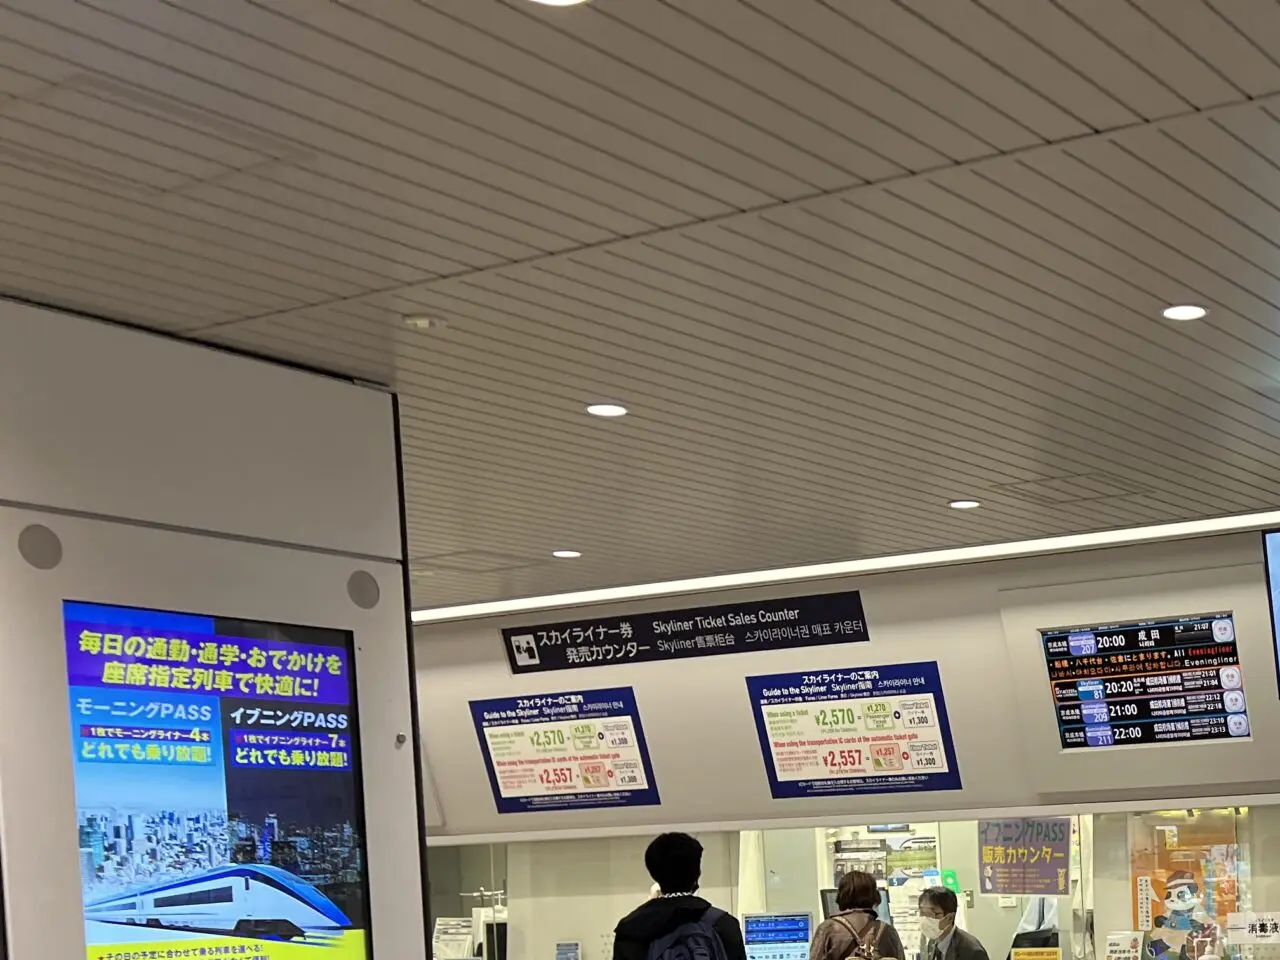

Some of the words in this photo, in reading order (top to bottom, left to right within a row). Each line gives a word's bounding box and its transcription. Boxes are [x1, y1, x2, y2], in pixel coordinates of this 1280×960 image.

[652, 617, 694, 635] Skyliner
[694, 615, 727, 630] Ticket
[727, 611, 757, 627] Sales
[758, 608, 800, 624] Counter
[1194, 623, 1209, 631] 21:07
[537, 622, 634, 647] スカイライナー券
[744, 624, 810, 643] 스카이라이너권
[811, 622, 832, 638] 매표
[833, 618, 864, 635] 카운터
[656, 632, 736, 651] Skyliner售票柜台
[1096, 634, 1126, 649] 20:00
[79, 630, 342, 675] 毎日の通勤・通学・おでかけを
[566, 641, 651, 664] 発売カウンター
[1081, 645, 1095, 655] 207
[1173, 649, 1186, 657] All
[1188, 646, 1233, 656] Eveningliner
[1184, 656, 1238, 667] Eveningliner
[102, 661, 319, 697] 座席指定列車で快適に!
[802, 670, 880, 685] スカイライナーのご案内
[762, 687, 782, 696] Guide
[782, 687, 789, 695] to
[789, 686, 800, 695] the
[800, 684, 827, 695] Skyliner
[1093, 690, 1103, 699] 81
[1104, 681, 1134, 694] 20:20
[516, 694, 584, 708] スカイライナーのご案内
[867, 703, 886, 712] ¥1,270
[76, 698, 212, 721] モーニングPASS
[483, 710, 500, 719] Guide
[506, 709, 517, 717] the
[516, 707, 540, 718] Skyliner
[1094, 713, 1108, 721] 209
[1109, 704, 1138, 717] 21:00
[230, 707, 349, 729] イブニングPASS
[814, 708, 855, 729] ¥2,570
[909, 716, 929, 725] ¥1,300
[530, 729, 565, 748] ¥2,570
[773, 740, 787, 749] When
[786, 739, 798, 750] using
[798, 739, 807, 747] the
[807, 736, 838, 748] transportation
[838, 737, 844, 745] IC
[844, 736, 857, 745] cards
[870, 733, 893, 743] automatic
[894, 732, 907, 741] ticket
[907, 732, 919, 741] gate
[1098, 736, 1112, 745] 211
[1113, 727, 1142, 740] 22:00
[80, 742, 212, 762] どれでも乗り放題!
[235, 748, 348, 767] どれでも乗り放題!
[822, 750, 863, 768] ¥2,557
[875, 747, 895, 756] ¥1,257
[916, 757, 936, 767] ¥1,300
[538, 767, 574, 785] ¥2,557
[980, 820, 1066, 844] イブニングPASS
[982, 845, 1065, 865] 販売カウンター
[1248, 922, 1280, 934] 消毒液
